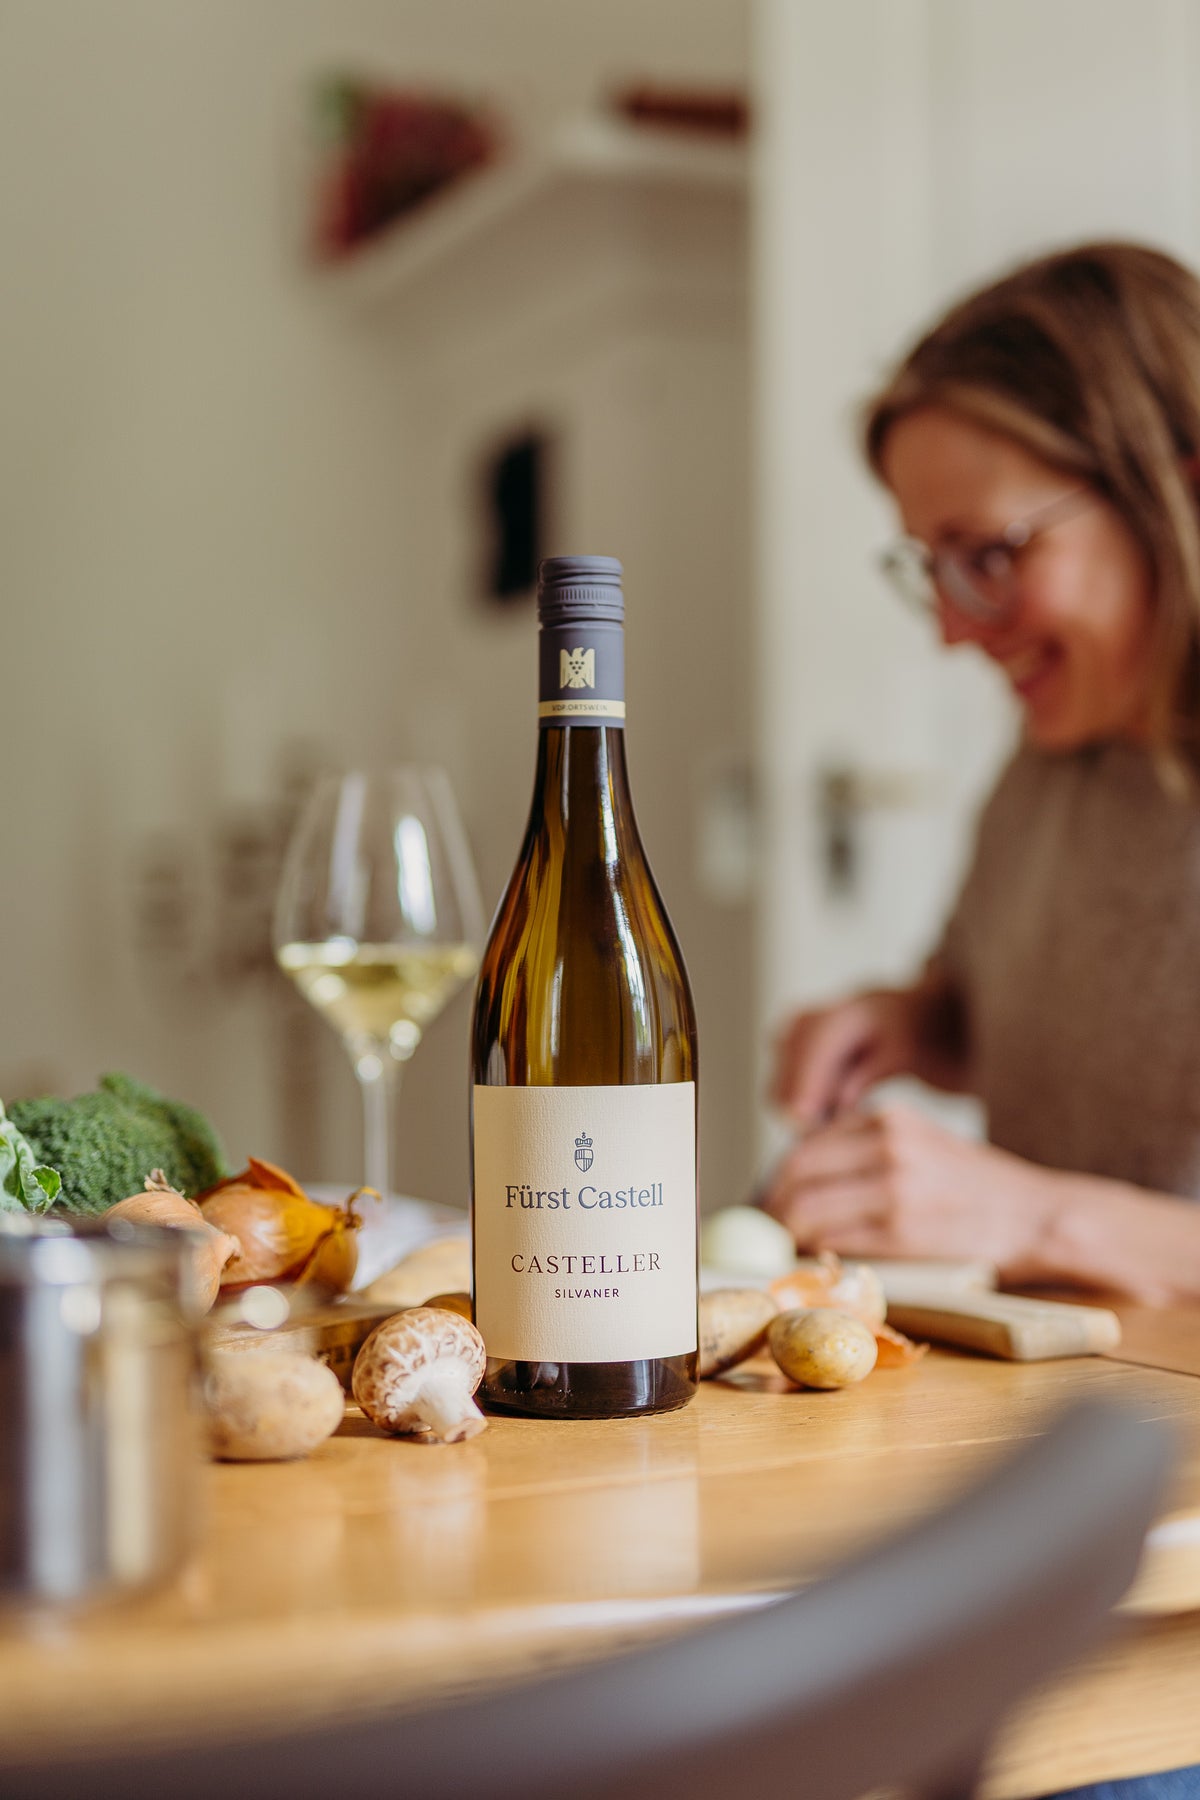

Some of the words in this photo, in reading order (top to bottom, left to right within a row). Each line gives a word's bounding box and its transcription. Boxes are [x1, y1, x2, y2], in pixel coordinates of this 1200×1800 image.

[505, 1184, 570, 1210] Fürst
[578, 1183, 663, 1209] Castell
[511, 1252, 662, 1274] CASTELLER
[555, 1288, 620, 1299] SILVANER
